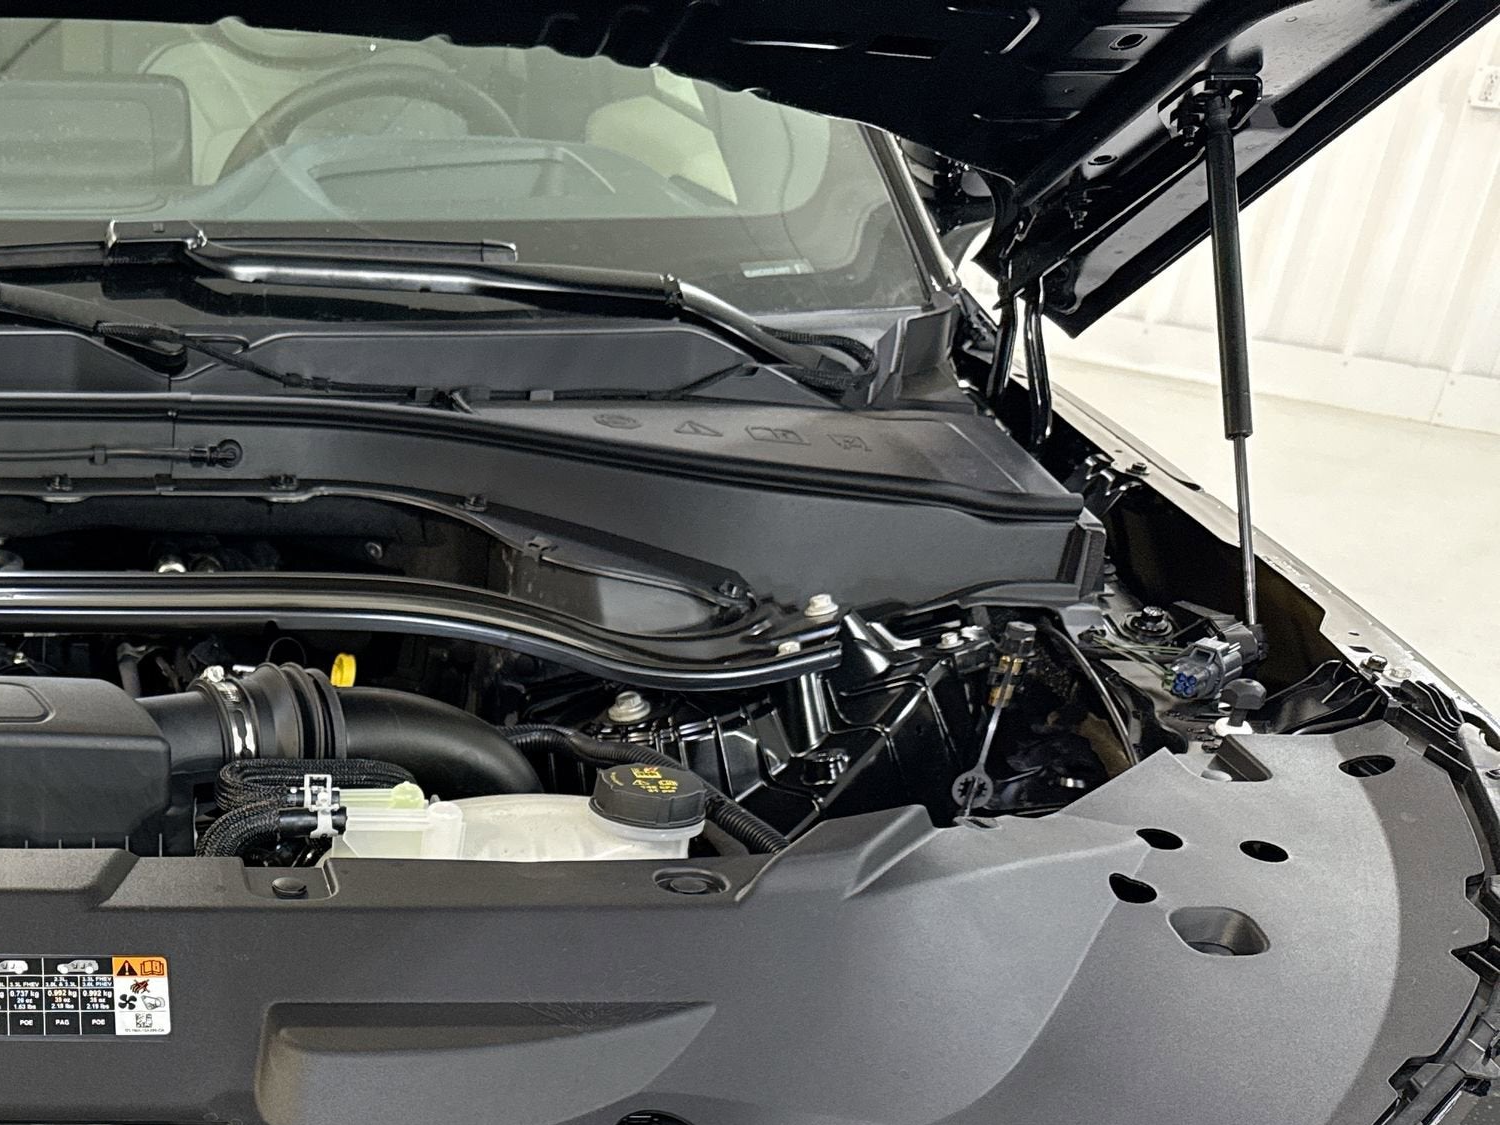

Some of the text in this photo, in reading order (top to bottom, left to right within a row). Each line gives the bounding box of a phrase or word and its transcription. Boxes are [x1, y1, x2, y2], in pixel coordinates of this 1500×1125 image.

[30, 990, 40, 998] kg
[68, 990, 77, 998] kg
[103, 990, 112, 998] kg
